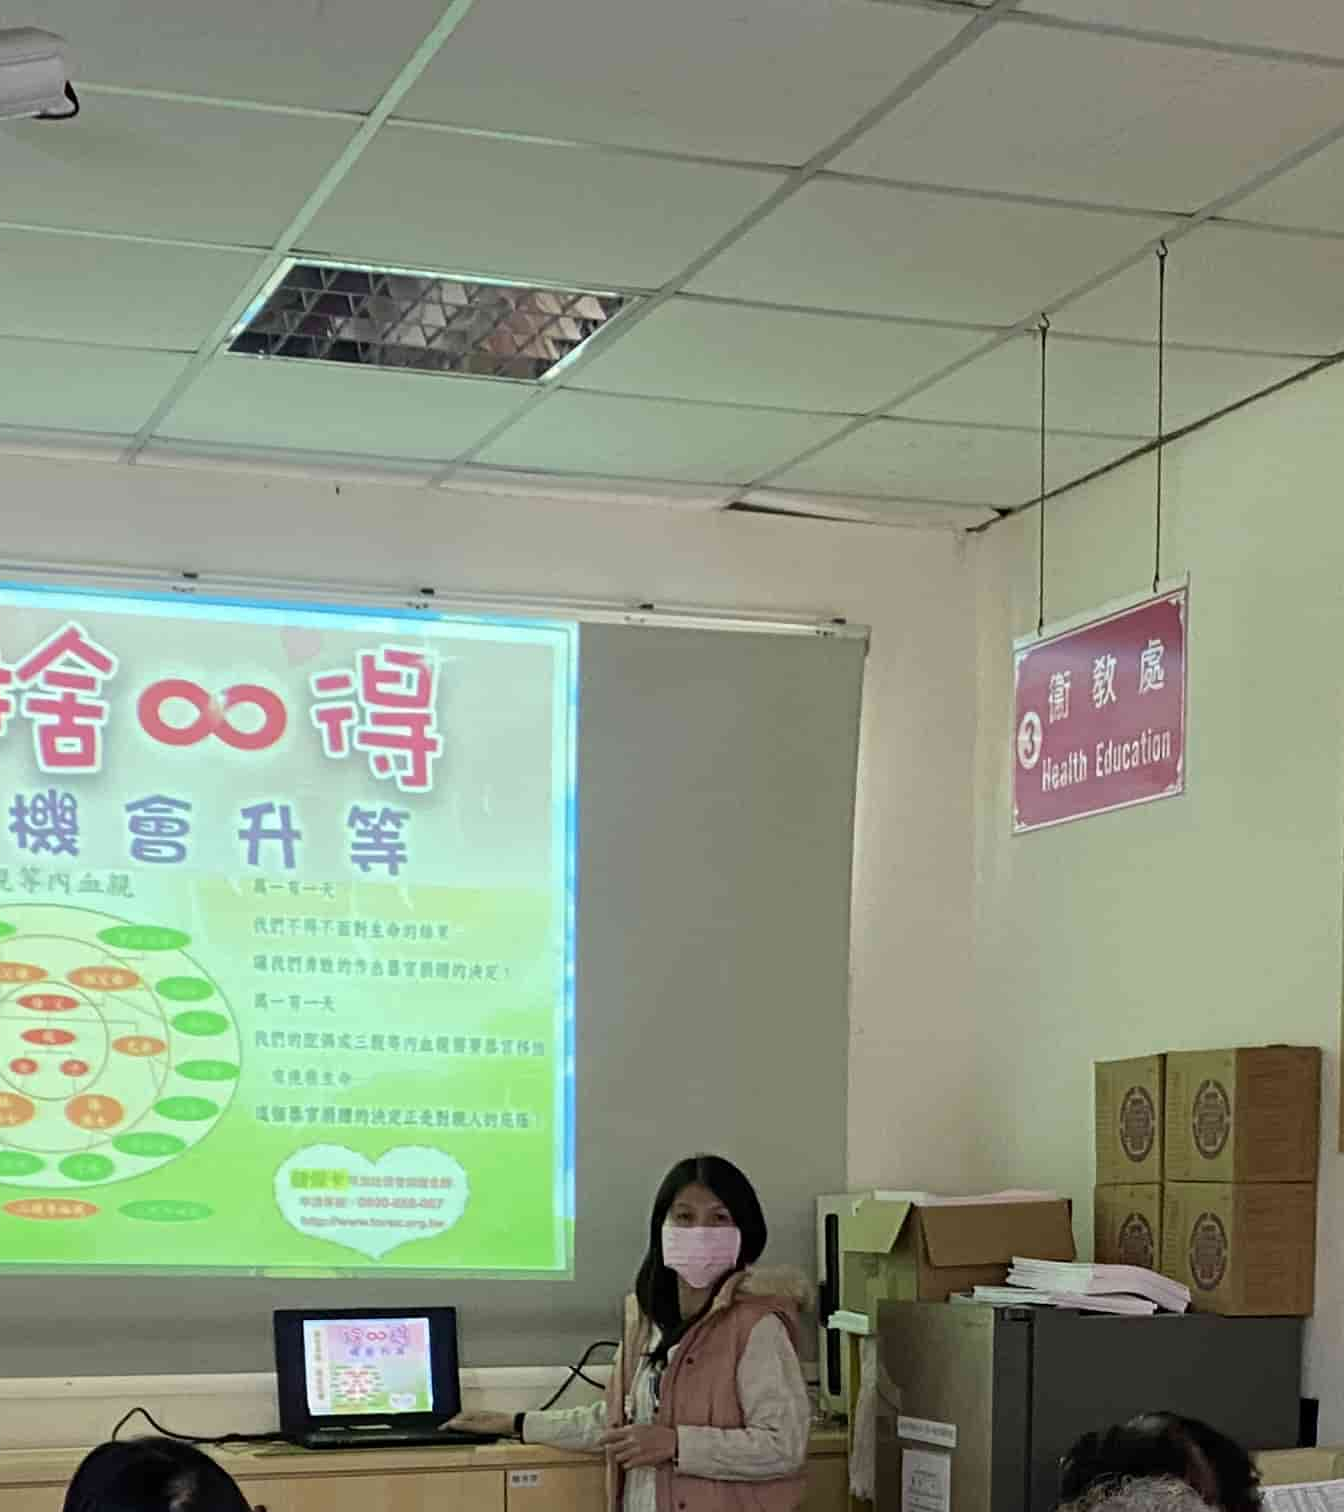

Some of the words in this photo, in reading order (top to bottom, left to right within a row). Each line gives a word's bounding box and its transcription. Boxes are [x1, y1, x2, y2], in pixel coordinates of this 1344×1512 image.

[1041, 749, 1088, 792] Health
[1095, 728, 1171, 777] Education
[8, 790, 410, 875] 機會升等
